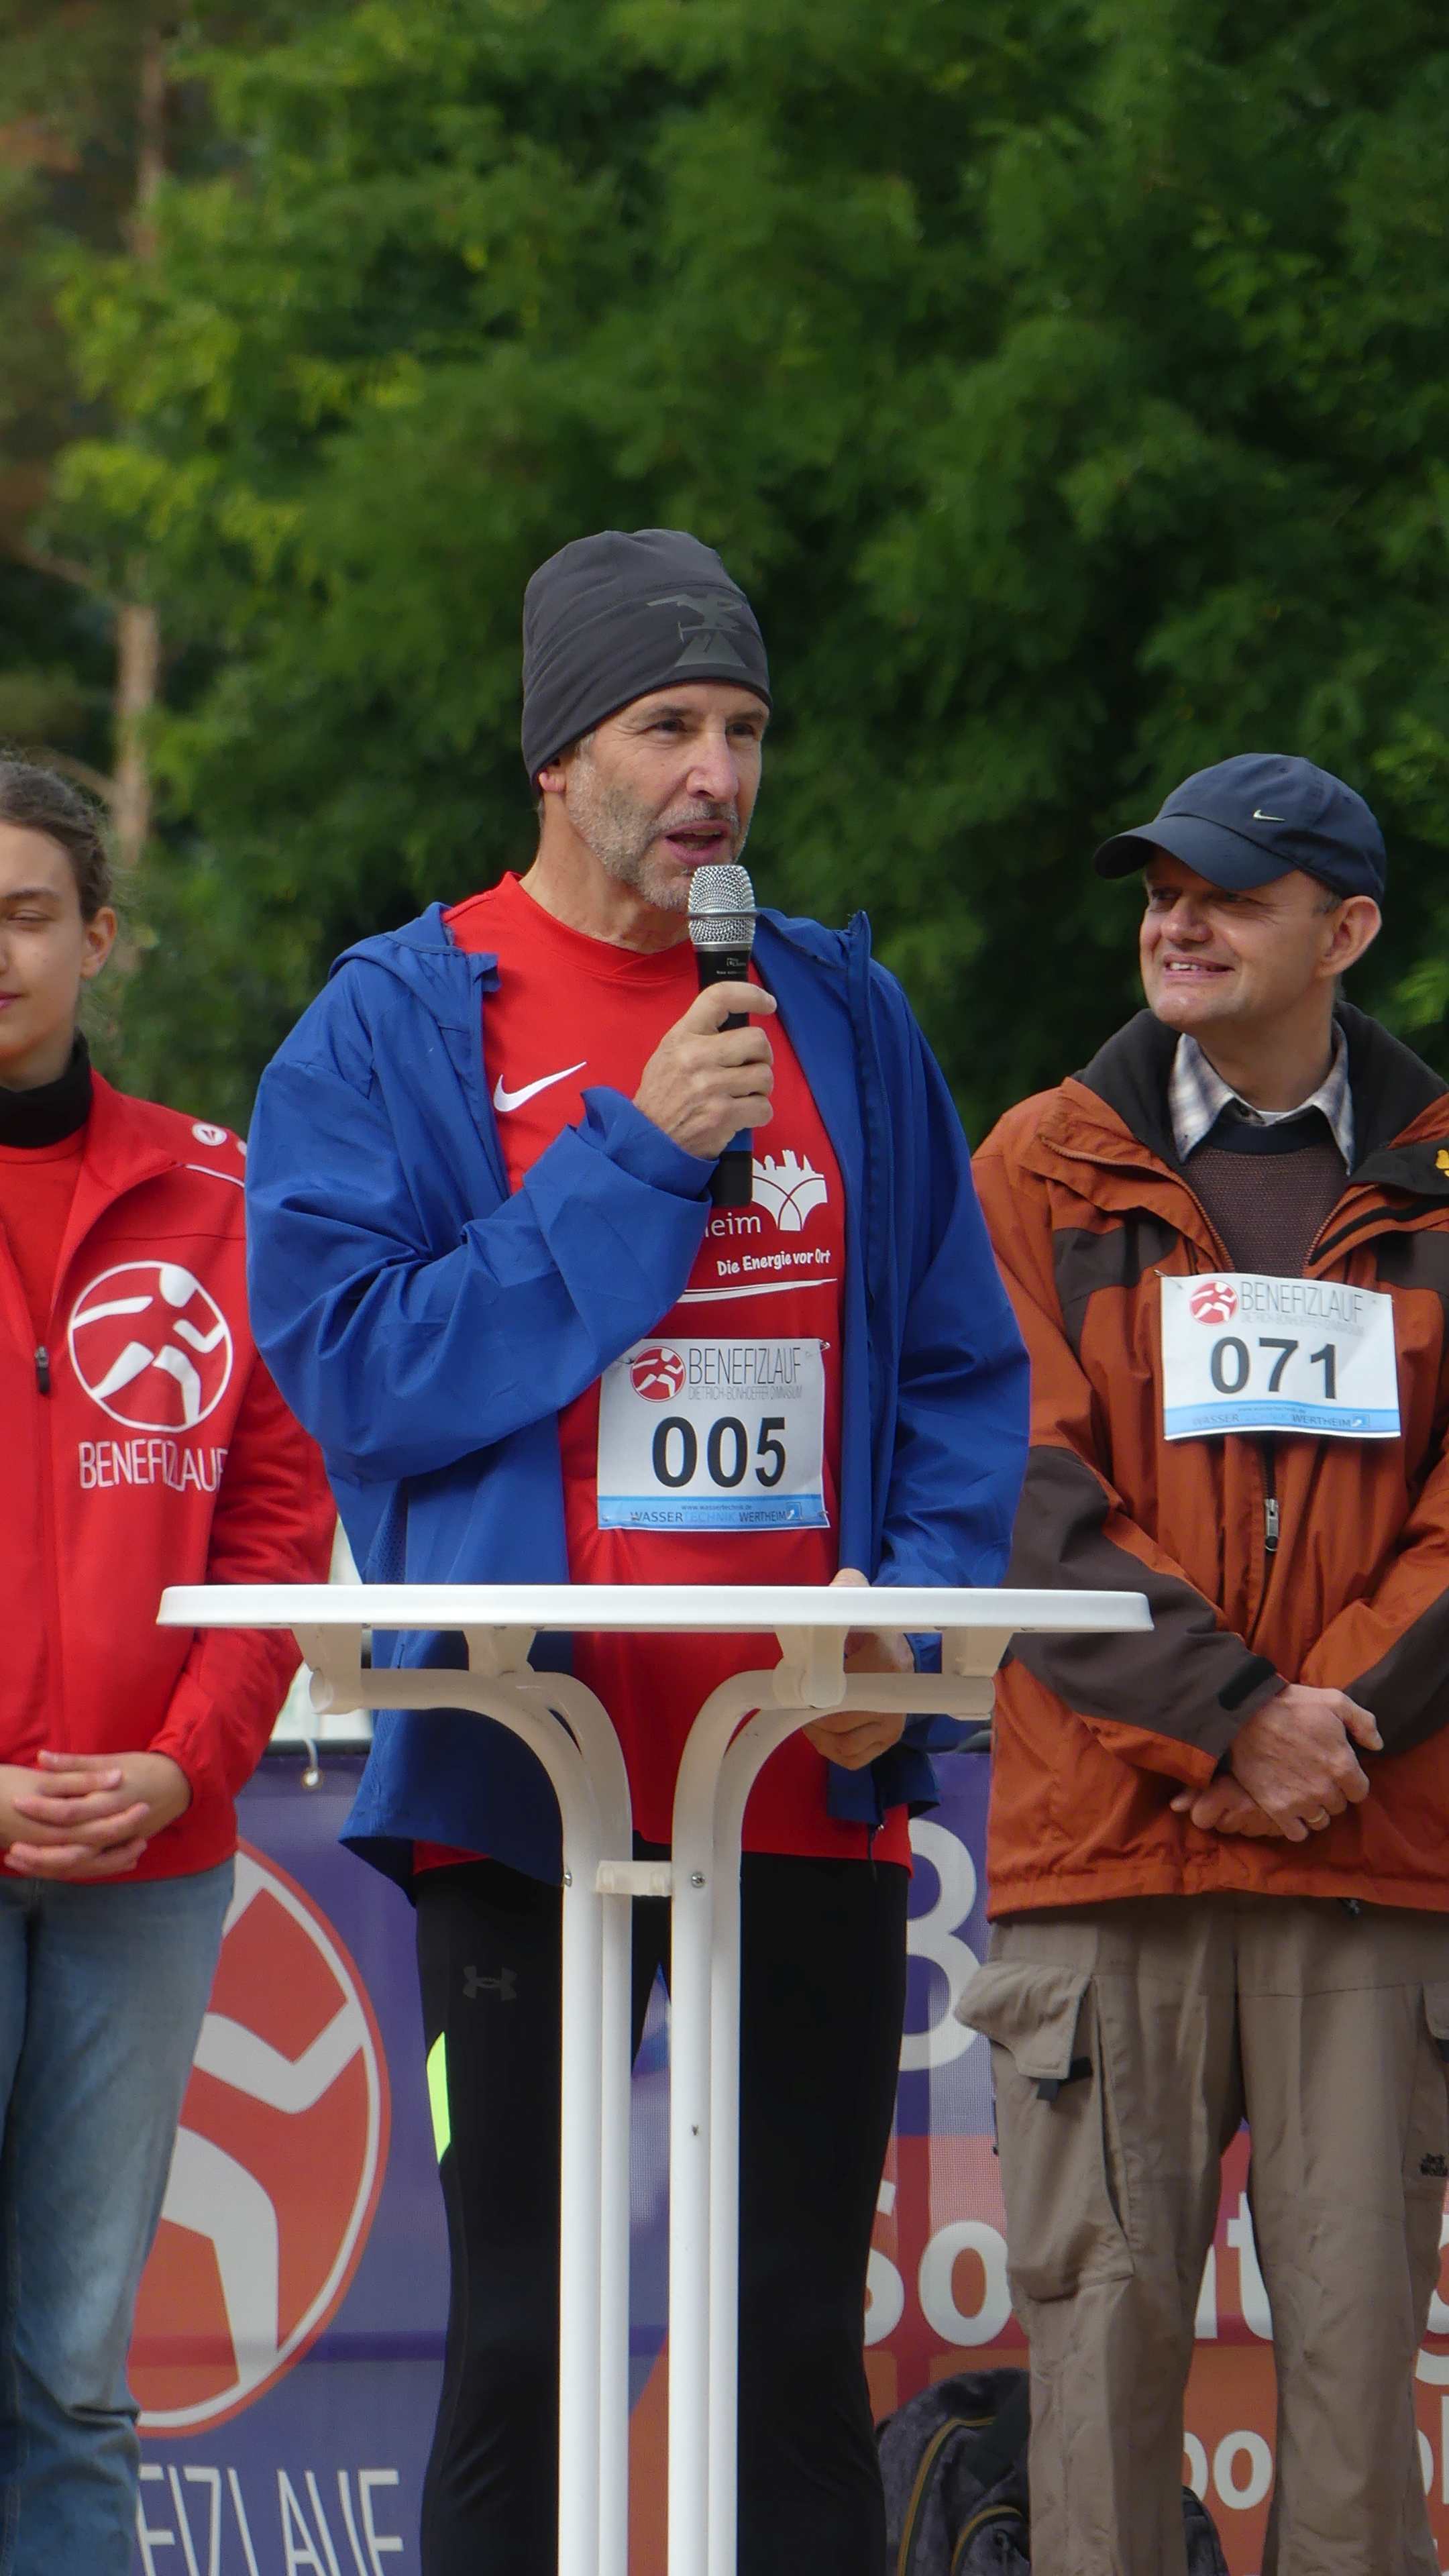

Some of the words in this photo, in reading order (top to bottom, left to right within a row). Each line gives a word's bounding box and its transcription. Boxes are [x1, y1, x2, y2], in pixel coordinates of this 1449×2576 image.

[704, 1212, 761, 1238] eim
[716, 1260, 740, 1276] Die
[743, 1250, 792, 1271] Energie
[793, 1252, 814, 1265] vor
[815, 1248, 831, 1264] Ort
[1240, 1281, 1363, 1324] BENEFIZLAUF
[688, 1347, 802, 1385] BENEFIZLAUF
[1210, 1336, 1337, 1400] 071
[652, 1416, 786, 1489] 005
[739, 1509, 787, 1523] WERTHEIM
